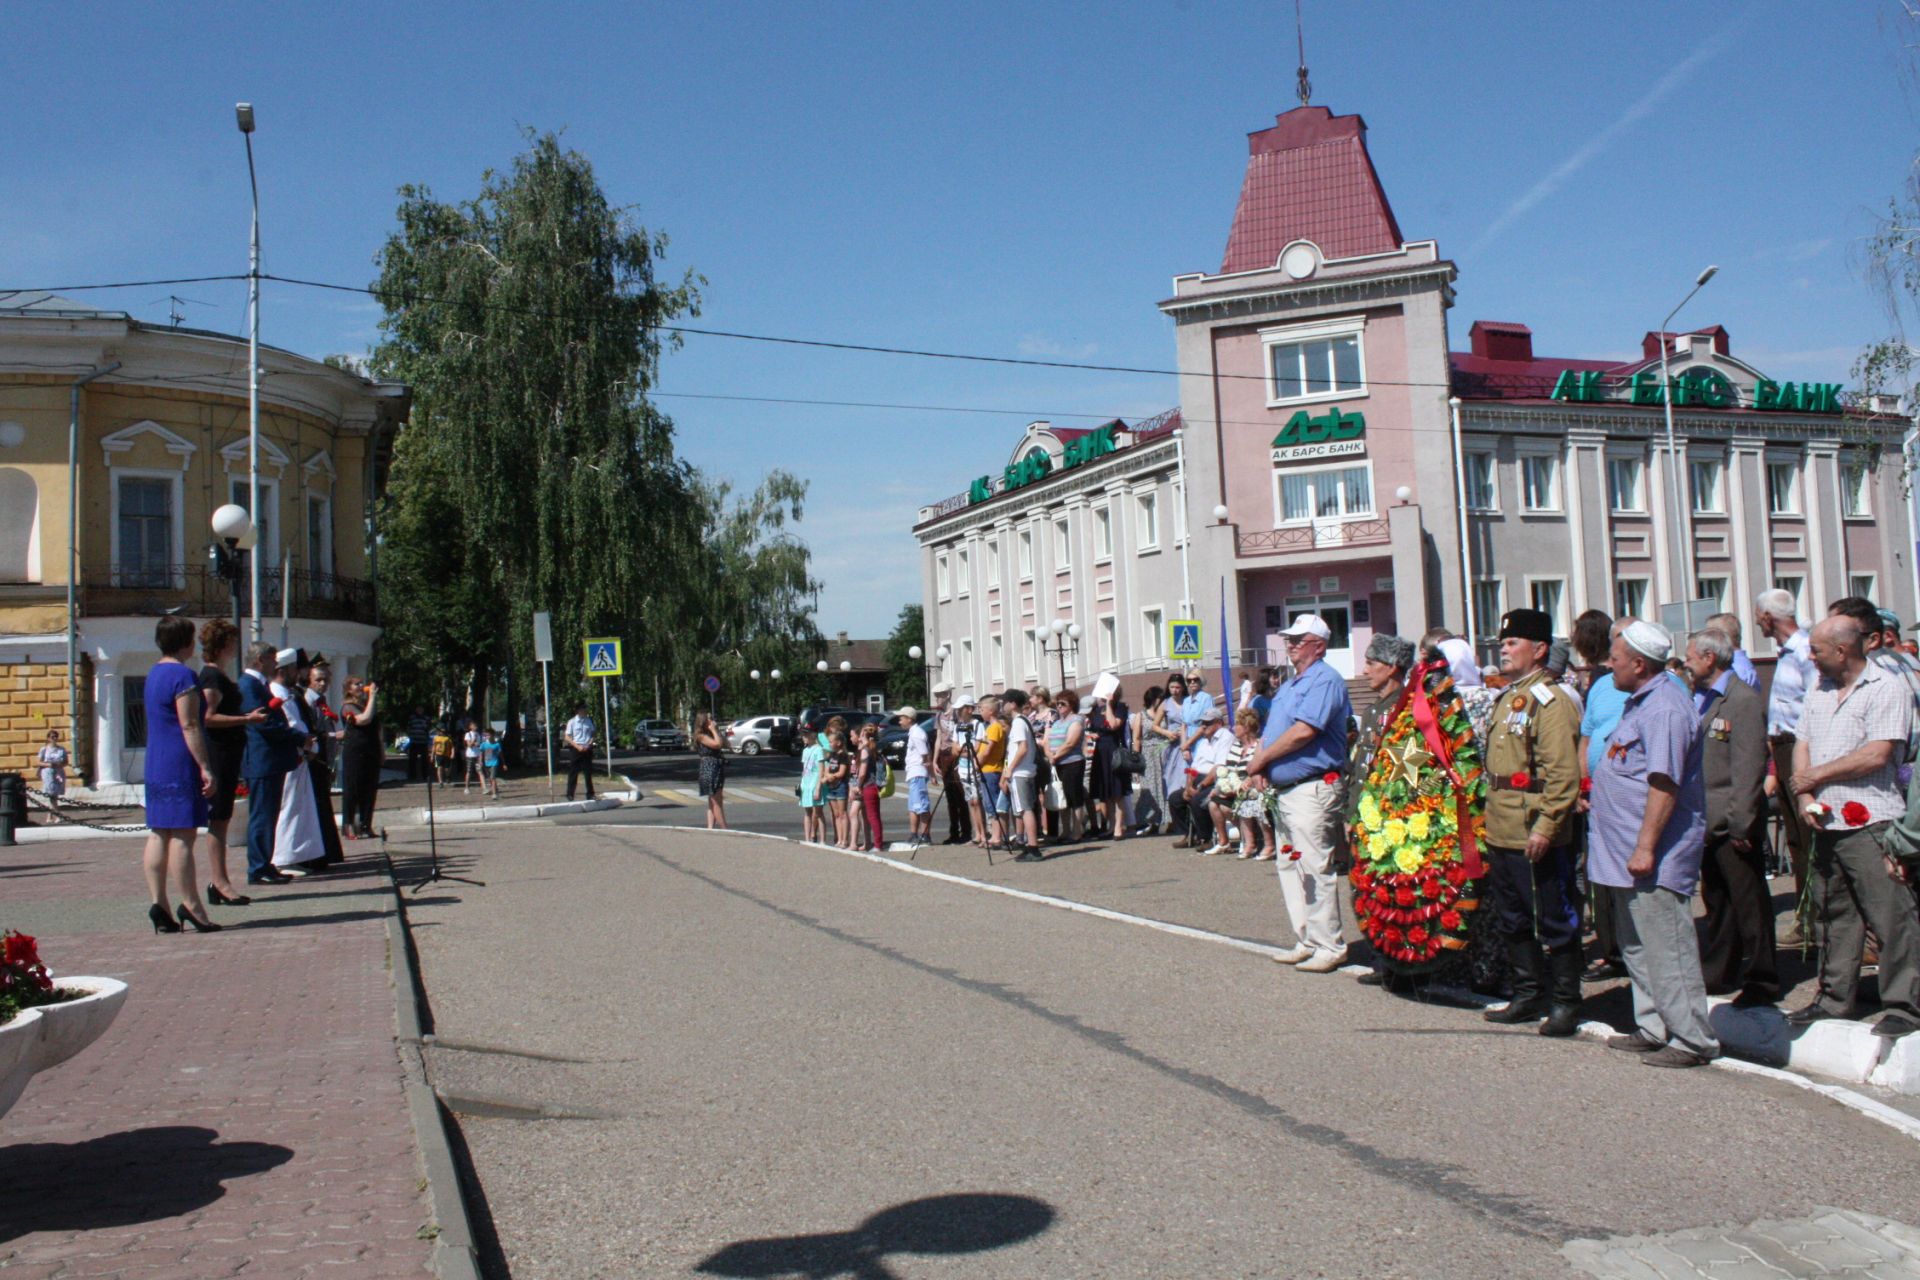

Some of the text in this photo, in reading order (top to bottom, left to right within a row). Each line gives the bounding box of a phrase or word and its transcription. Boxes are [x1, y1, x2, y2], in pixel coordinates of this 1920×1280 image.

[1550, 369, 1843, 412] АК БАРС БАНК
[1005, 449, 1050, 491] БАРС
[1063, 422, 1116, 469] БАНК
[1272, 442, 1363, 460] АК БАРС БАНК
